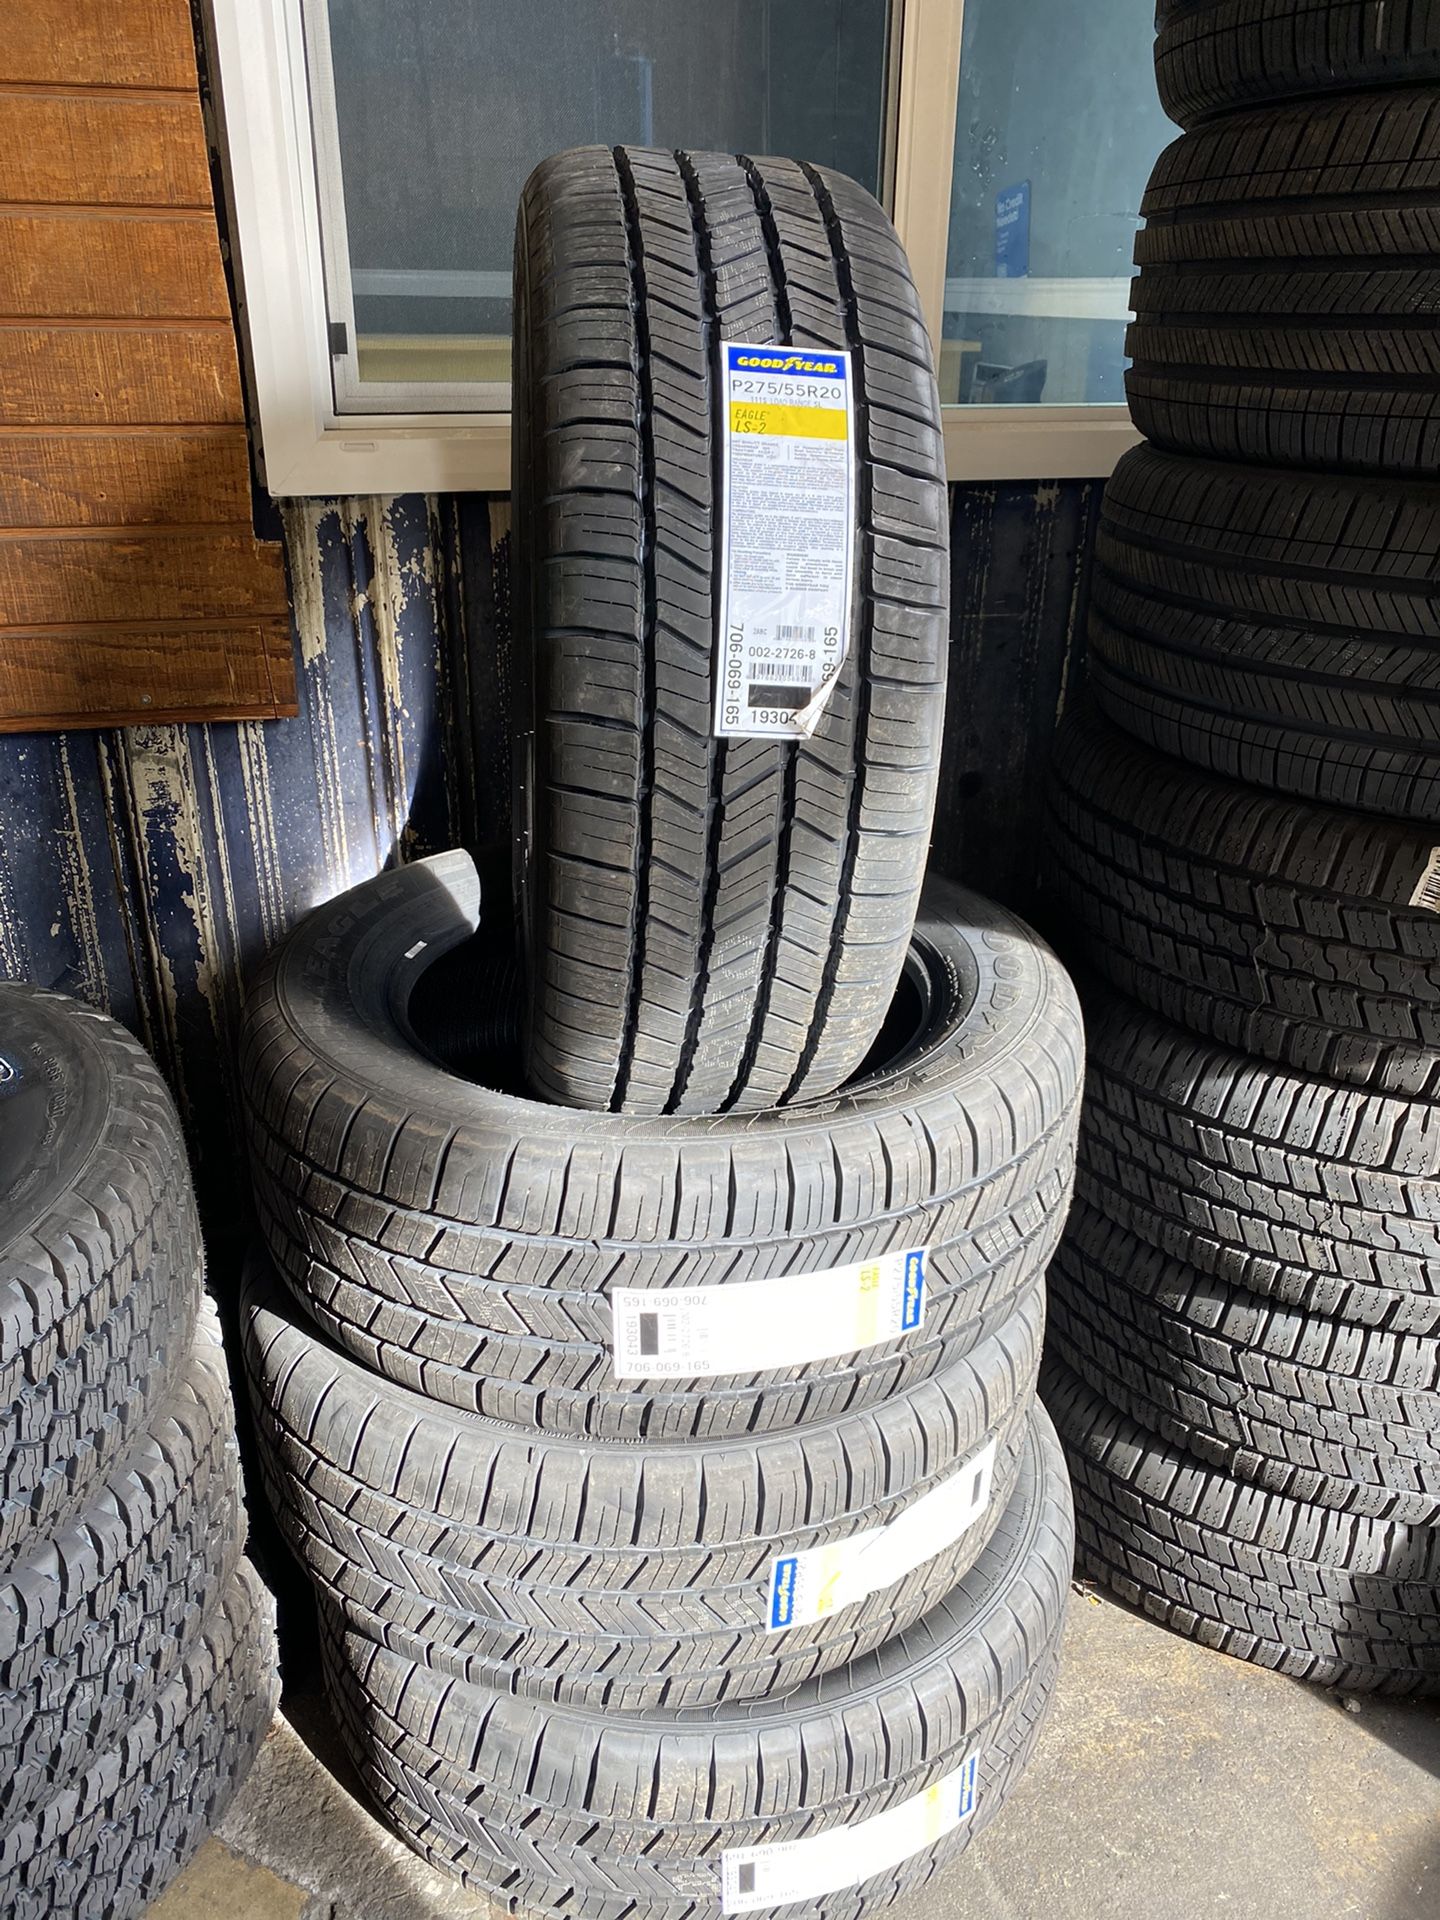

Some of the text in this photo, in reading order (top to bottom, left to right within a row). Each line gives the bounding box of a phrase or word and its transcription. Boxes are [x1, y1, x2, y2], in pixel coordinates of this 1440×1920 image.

[737, 356, 838, 374] GOODYEAR
[732, 379, 841, 400] P275/55R20
[735, 408, 766, 421] EAGLE
[735, 420, 767, 434] LS-2
[748, 646, 816, 660] 002-2726-8
[725, 622, 745, 724] 706-069-165
[625, 1314, 639, 1357] 193043
[625, 1360, 711, 1373] 706-069-165
